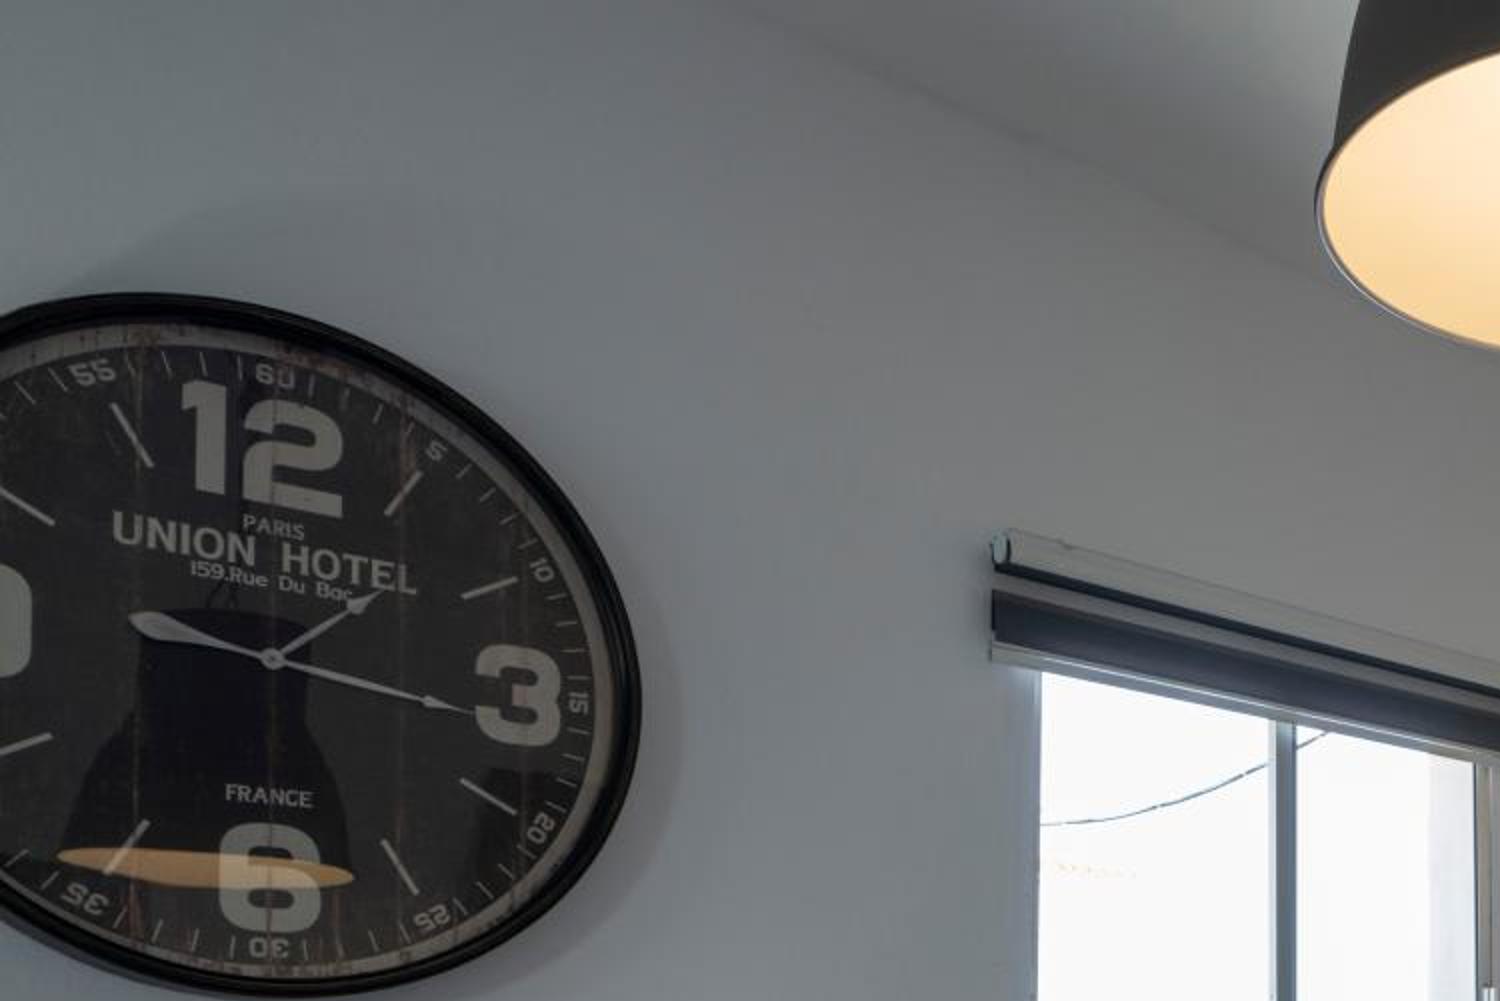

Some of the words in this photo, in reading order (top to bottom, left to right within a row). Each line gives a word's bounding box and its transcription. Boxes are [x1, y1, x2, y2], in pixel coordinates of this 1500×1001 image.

[68, 357, 118, 387] 55
[255, 363, 295, 390] 60
[181, 379, 343, 518] 12
[425, 439, 448, 462] 5
[242, 513, 306, 541] PARIS
[112, 509, 256, 567] UNION
[281, 541, 418, 595] HOTEL
[278, 575, 306, 594] Du
[530, 558, 555, 583] 10
[475, 643, 562, 747] 3
[569, 691, 589, 715] 15
[225, 783, 314, 808] FRANCE
[527, 813, 556, 845] 20
[218, 821, 321, 933] 6
[60, 881, 110, 916] 35
[414, 902, 451, 931] 25
[249, 936, 289, 959] 30
